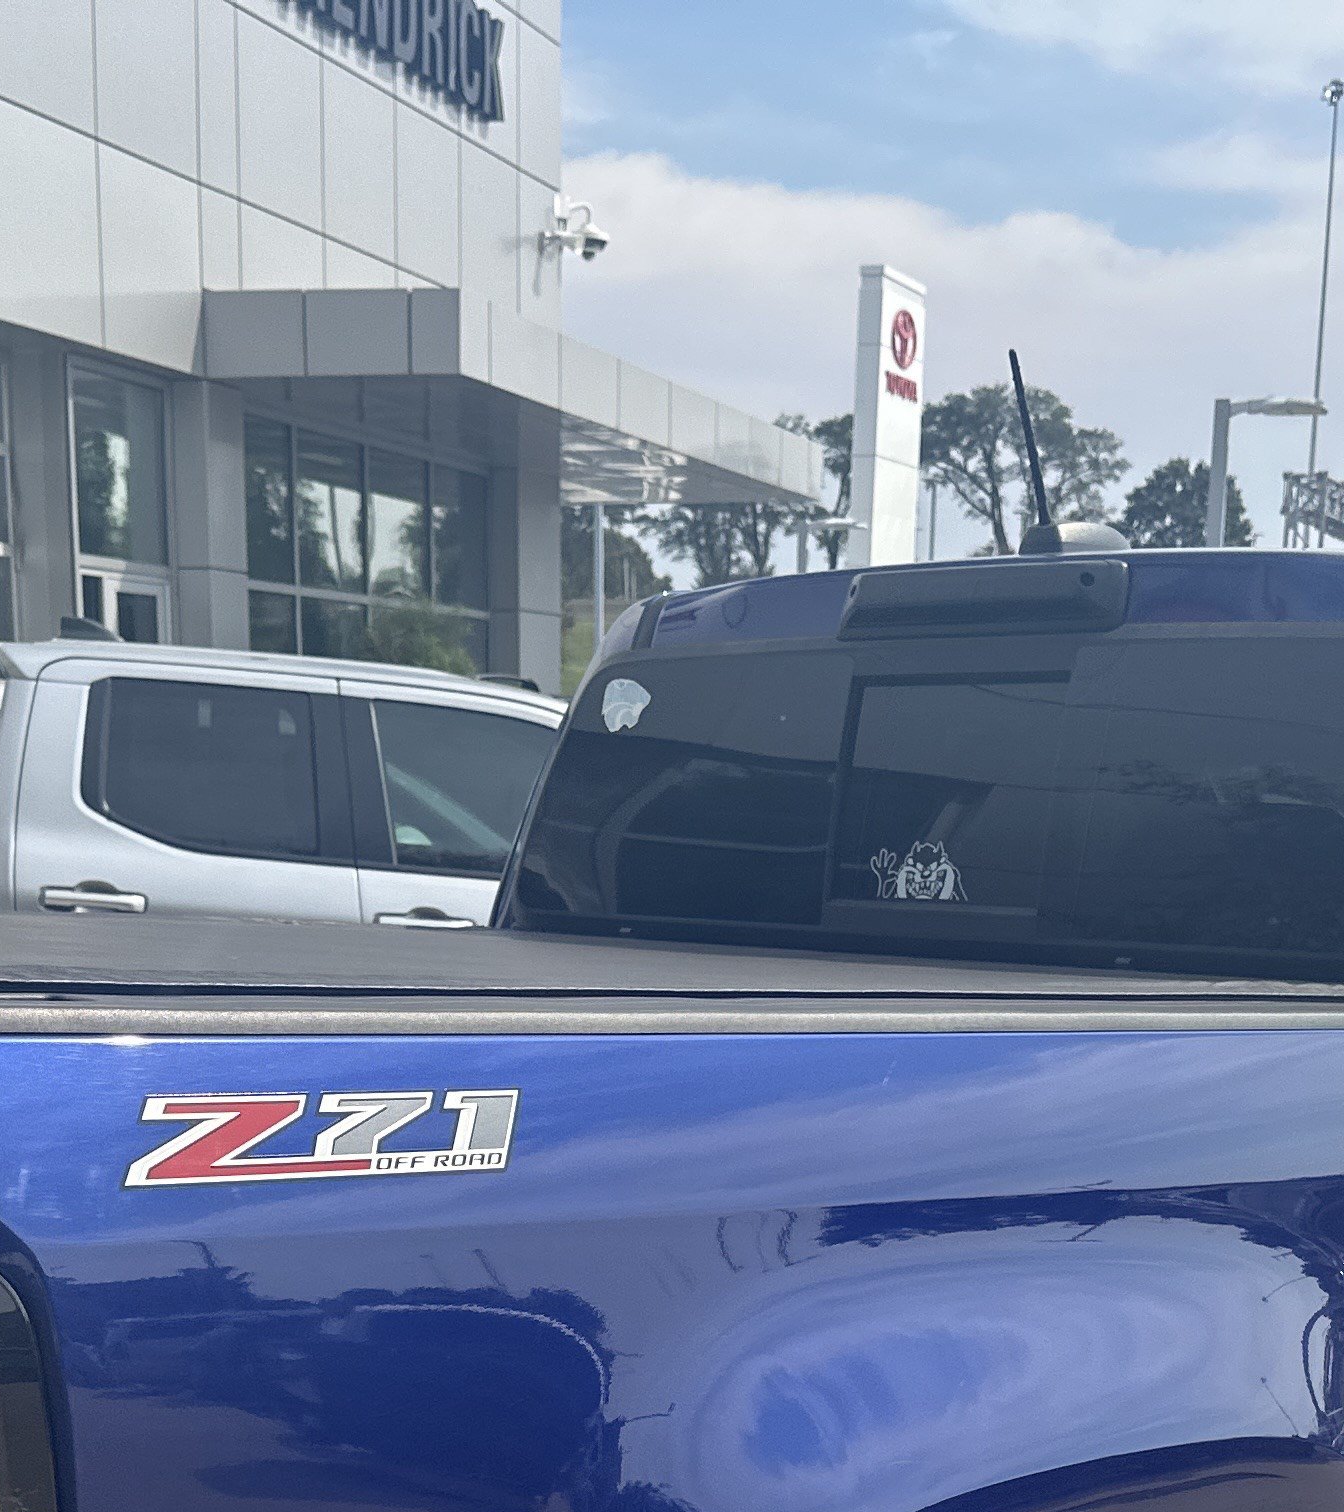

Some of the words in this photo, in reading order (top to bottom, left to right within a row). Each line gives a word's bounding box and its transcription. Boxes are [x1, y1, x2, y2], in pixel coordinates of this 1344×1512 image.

[298, 0, 504, 121] NDRICK
[125, 1089, 519, 1188] Z71
[375, 1155, 425, 1170] OFF
[434, 1151, 503, 1167] ROAD
